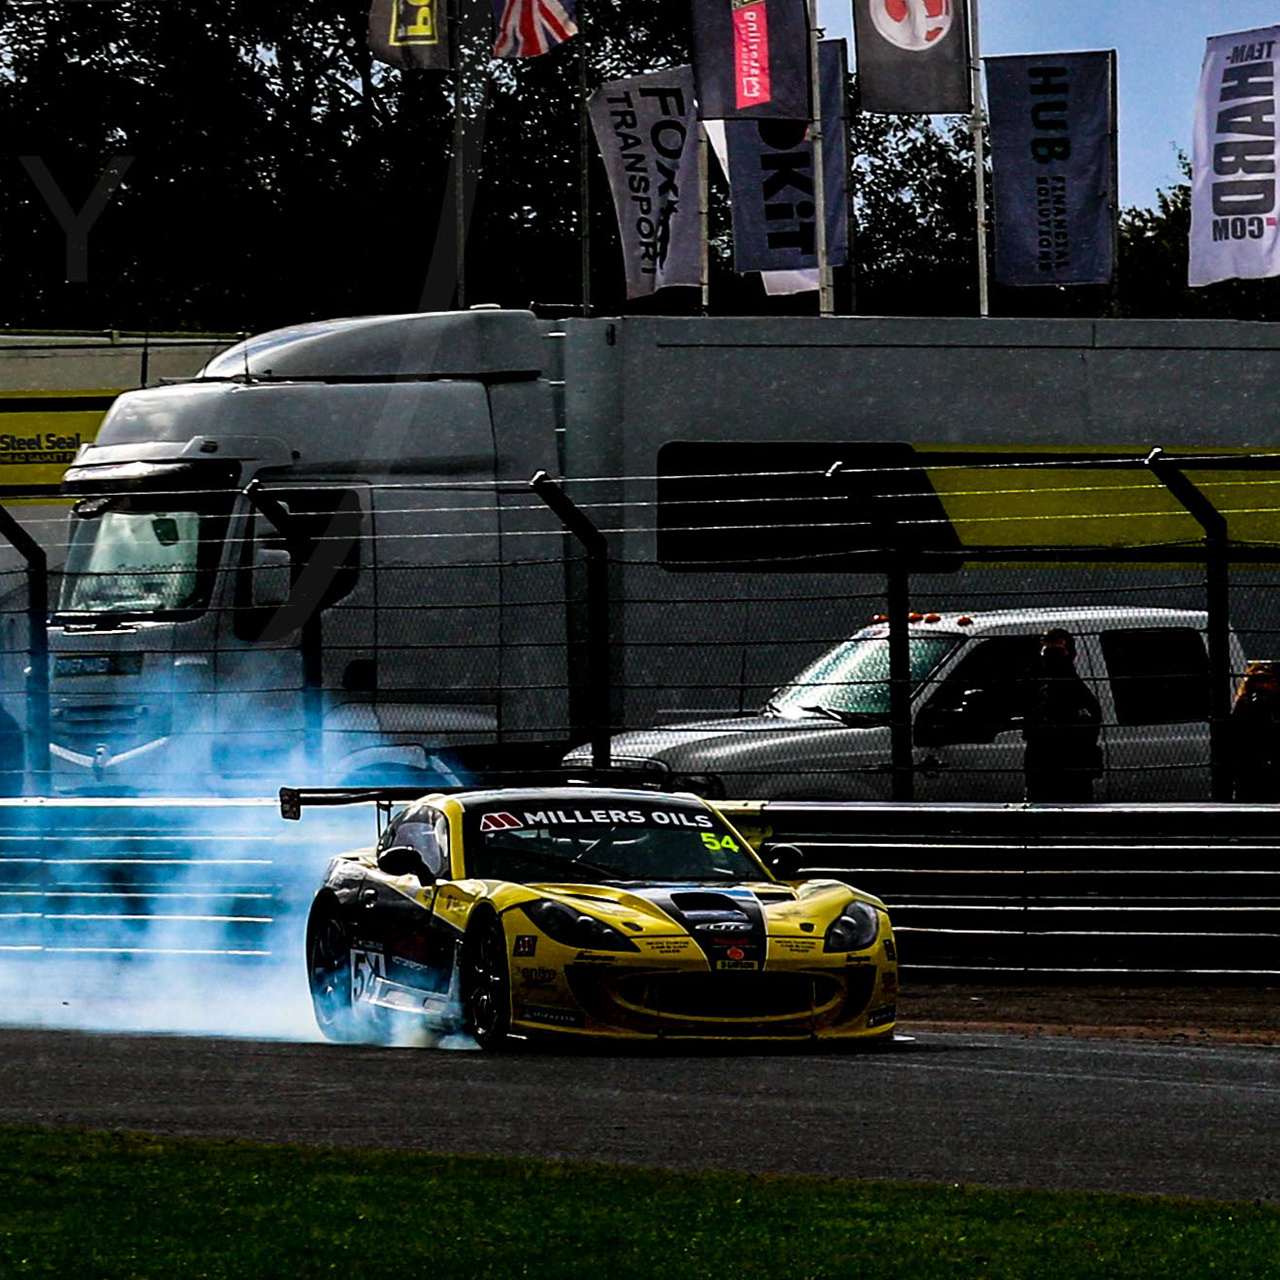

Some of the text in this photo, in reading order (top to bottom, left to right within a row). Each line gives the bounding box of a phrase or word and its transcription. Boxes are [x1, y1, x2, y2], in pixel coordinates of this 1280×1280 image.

[640, 87, 687, 199] FOX
[1028, 66, 1071, 164] HUB
[1036, 176, 1052, 272] SOLUTIONS
[1052, 176, 1070, 270] FINANCIAL
[0, 433, 82, 451] Steel Seal
[524, 810, 714, 828] MILLERS OILS
[700, 832, 740, 853] 54
